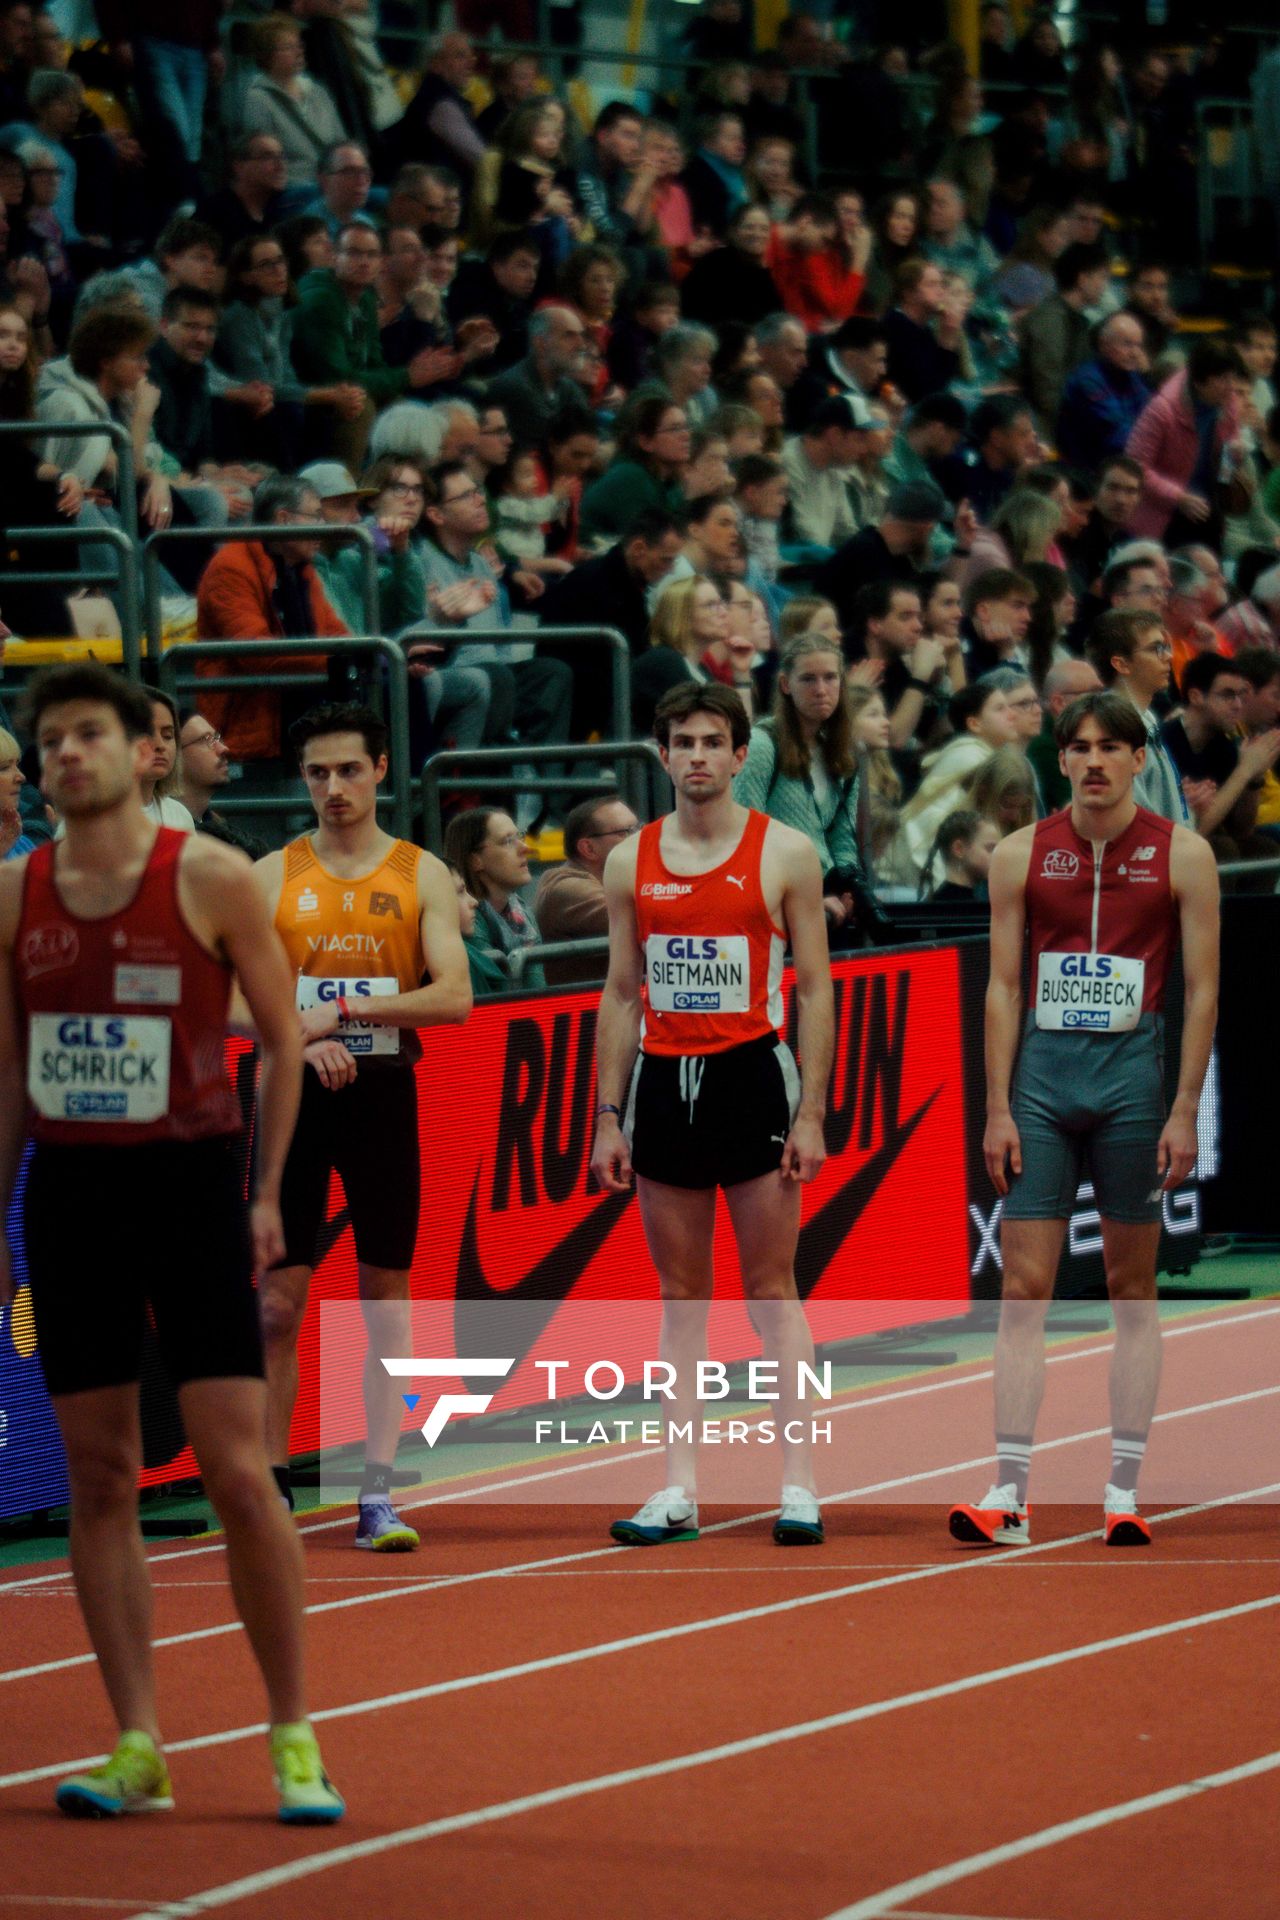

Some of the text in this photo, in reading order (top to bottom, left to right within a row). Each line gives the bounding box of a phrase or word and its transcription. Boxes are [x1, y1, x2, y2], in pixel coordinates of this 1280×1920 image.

[653, 883, 693, 896] Brillux
[306, 932, 386, 953] VIACTIV
[652, 961, 742, 986] SIETMANN
[691, 995, 719, 1005] PLAN
[1041, 979, 1137, 1007] BUSCHBECK
[1081, 1012, 1109, 1023] PLAN
[344, 1036, 372, 1046] PLAN
[40, 1050, 158, 1086] SCHRICK
